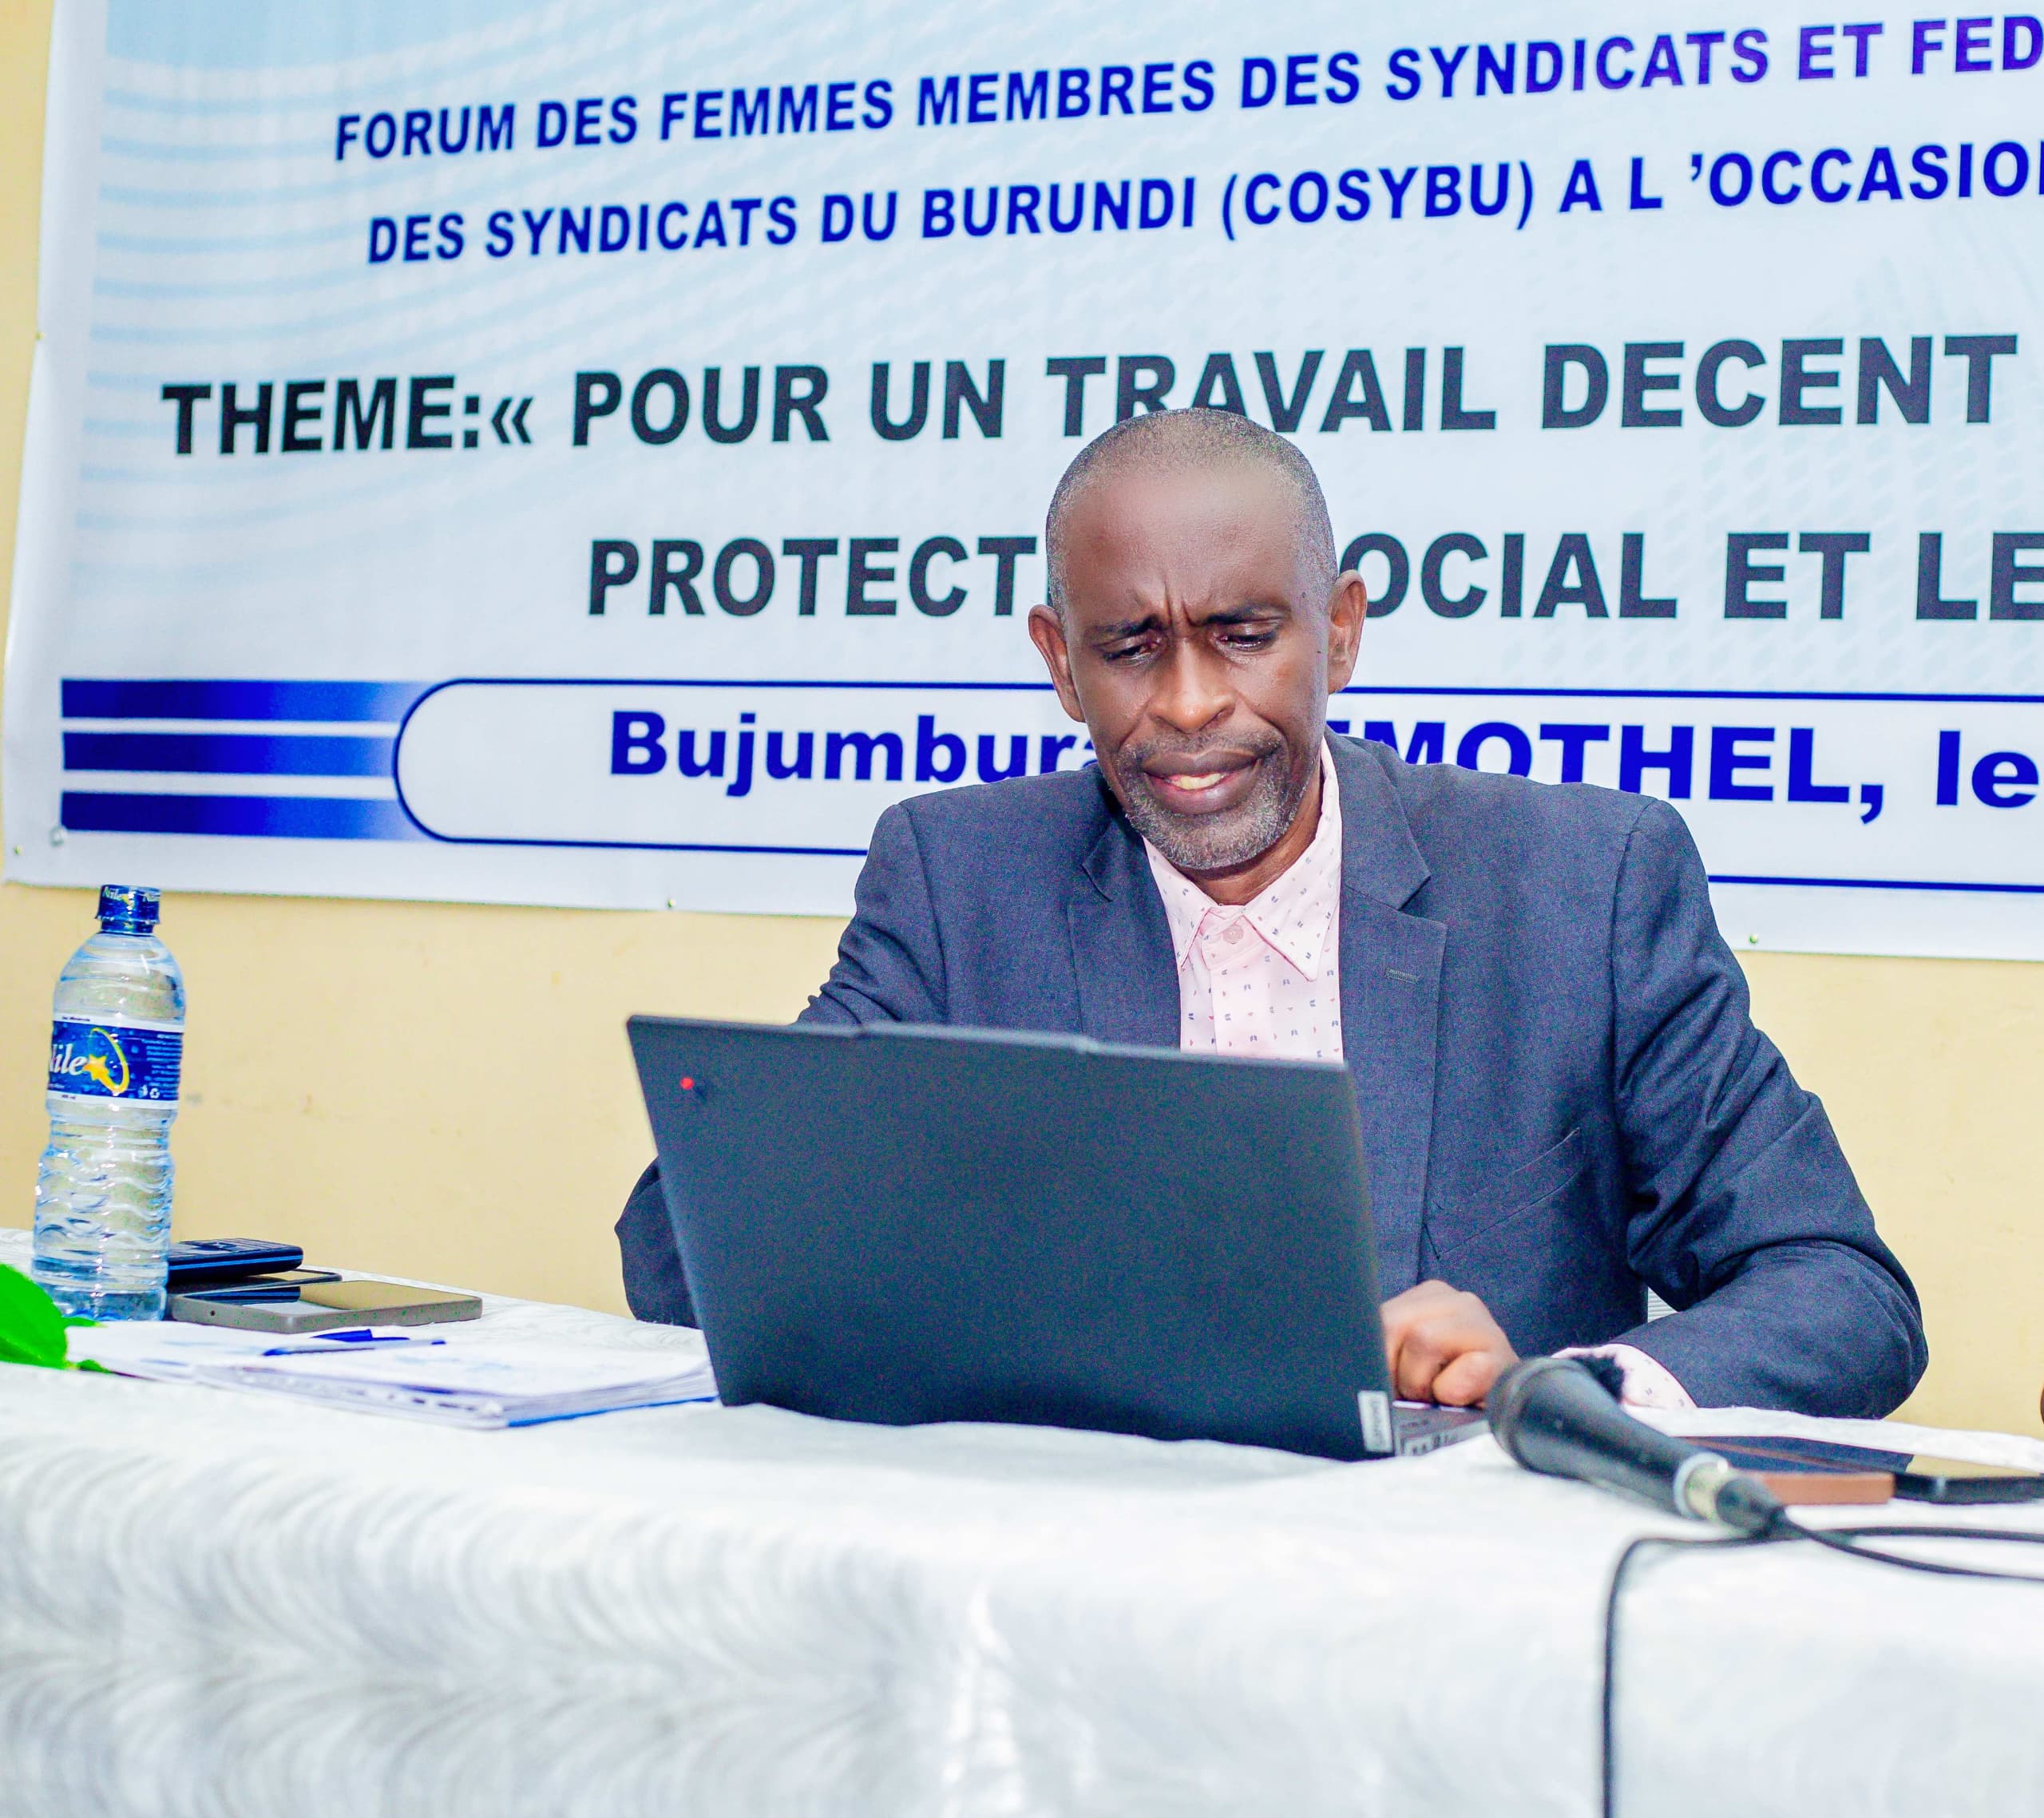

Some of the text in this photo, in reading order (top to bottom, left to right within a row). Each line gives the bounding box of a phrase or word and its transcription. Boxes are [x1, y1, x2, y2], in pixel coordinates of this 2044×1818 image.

[336, 15, 2044, 161] FORUM DES FEMMES MEMBRES DES SYNDICATS ET FED
[369, 141, 2044, 263] DES SYNDICATS DU BURUNDI (COSYBU) A L ’OCCASIO
[573, 366, 830, 446] POUR
[871, 359, 1005, 441] UN
[1046, 347, 1496, 436] TRAVAIL
[1543, 335, 2017, 429] DECENT
[588, 533, 2044, 620] PROTECT OCIAL ET LE
[1936, 730, 2040, 809] le
